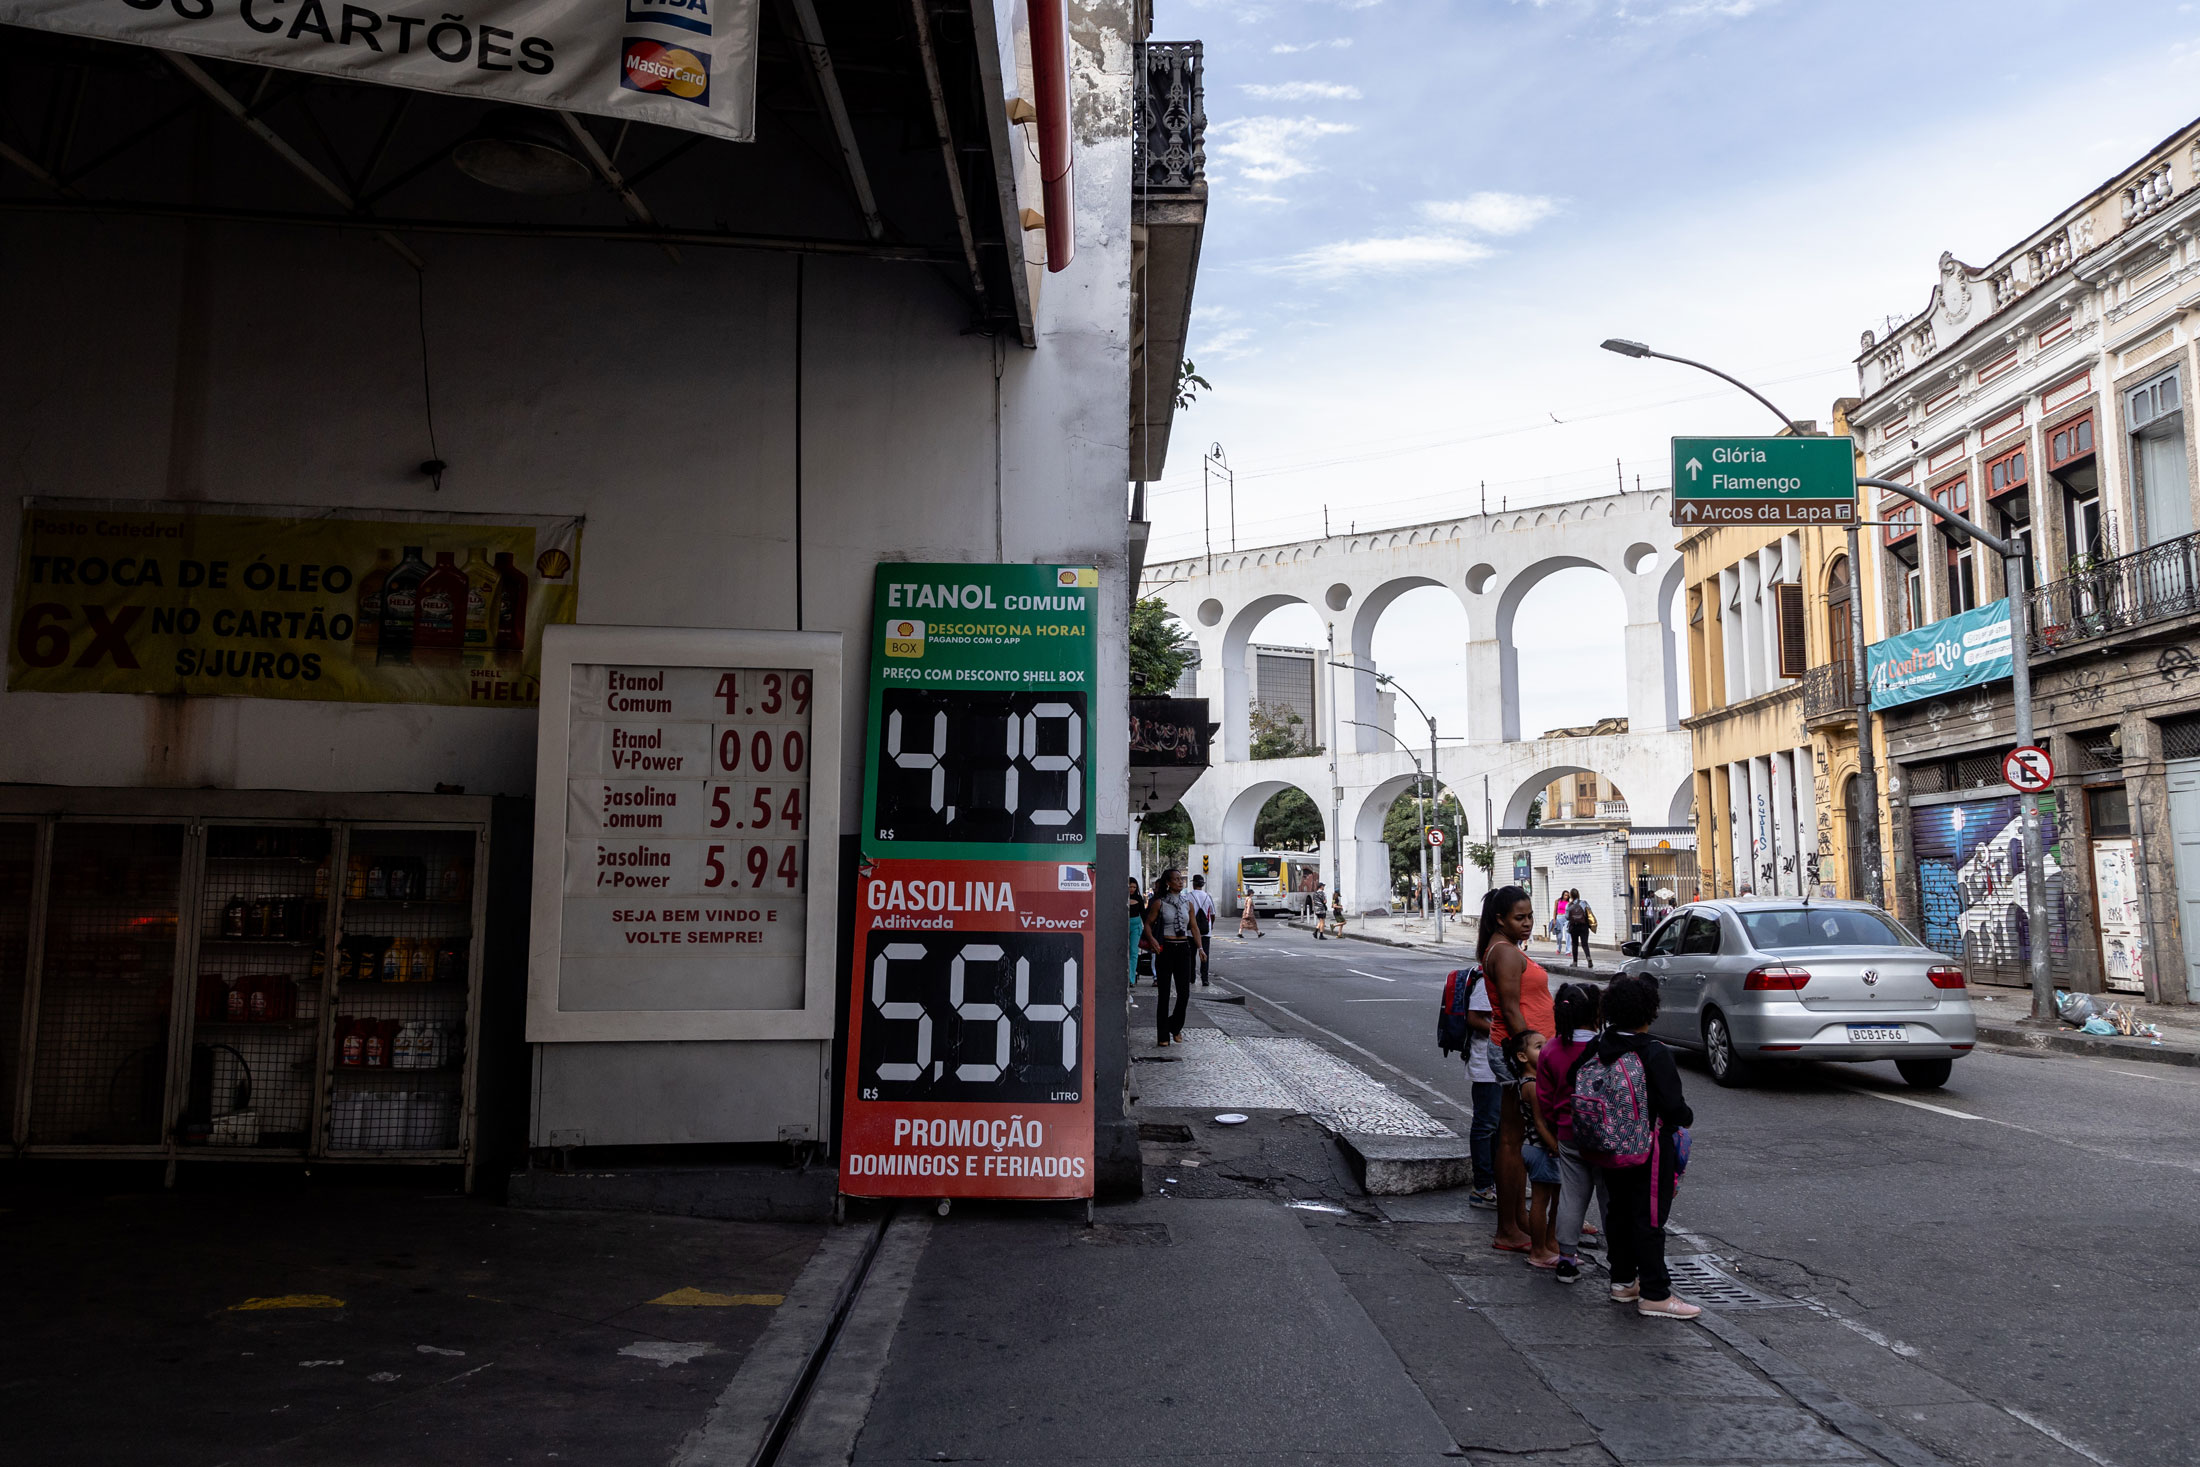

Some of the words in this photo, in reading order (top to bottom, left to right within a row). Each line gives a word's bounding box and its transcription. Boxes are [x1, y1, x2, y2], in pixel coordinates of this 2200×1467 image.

[240, 0, 555, 75] CARTÕES
[626, 54, 705, 87] MasterCard
[1712, 447, 1767, 464] Glória
[1712, 474, 1801, 493] Flamengo
[1702, 504, 1753, 520] Arcos
[1758, 504, 1780, 520] da
[1786, 504, 1832, 522] Lapa
[33, 518, 88, 537] Posto
[95, 519, 185, 539] Catedral
[30, 555, 163, 588] TROCA
[178, 559, 229, 589] DE
[243, 553, 354, 594] ÓLEO
[422, 602, 450, 610] HELIX
[888, 583, 997, 610] ETANOL
[1004, 595, 1085, 611] COMUM
[152, 607, 201, 636] NO
[213, 606, 354, 641] CARTÃO
[928, 623, 1008, 637] DESCONTO
[1010, 624, 1032, 637] NA
[1036, 624, 1086, 637] HORA!
[17, 602, 146, 670] 6X
[928, 636, 974, 644] PAGANDO
[975, 637, 993, 645] COM
[994, 637, 1002, 645] O
[1003, 637, 1021, 645] APP
[892, 642, 917, 654] BOX
[175, 648, 322, 681] S/JUROS
[1888, 639, 1962, 679] ConfraRio
[471, 669, 502, 678] SHELL
[608, 670, 664, 692] Etanol
[883, 668, 921, 683] PREÇO
[924, 669, 953, 682] COM
[956, 669, 1020, 682] DESCONTO
[1023, 670, 1056, 682] SHELL
[1059, 670, 1085, 683] BOX
[471, 681, 540, 702] HELI
[714, 672, 812, 716] 4.39
[607, 692, 672, 714] Comum
[612, 728, 662, 750] Etanol
[612, 750, 684, 772] V-Power
[887, 702, 1082, 826] 4,19
[709, 786, 803, 831] 5.54
[880, 828, 895, 841] R$
[1056, 833, 1083, 842] LITRO
[704, 845, 799, 889] 5.94
[1560, 852, 1570, 866] São
[1570, 850, 1592, 865] Martinho
[867, 880, 1015, 912] GASOLINA
[611, 909, 658, 923] SEJA
[662, 910, 700, 924] BEM
[705, 910, 761, 923] VINDO
[767, 910, 778, 923] E
[871, 915, 954, 930] Aditivada
[1020, 916, 1085, 929] V-Power
[625, 931, 682, 945] VOLTE
[687, 930, 764, 945] SEMPRE!
[871, 943, 1078, 1083] 5,54
[1853, 1029, 1902, 1040] BCB1F66
[863, 1087, 879, 1101] R$
[1050, 1092, 1079, 1101] LITRO
[894, 1114, 1043, 1153] PROMOÇÃO
[850, 1155, 960, 1177] DOMINGOS
[965, 1156, 978, 1177] E
[984, 1156, 1086, 1179] FERIADOS
